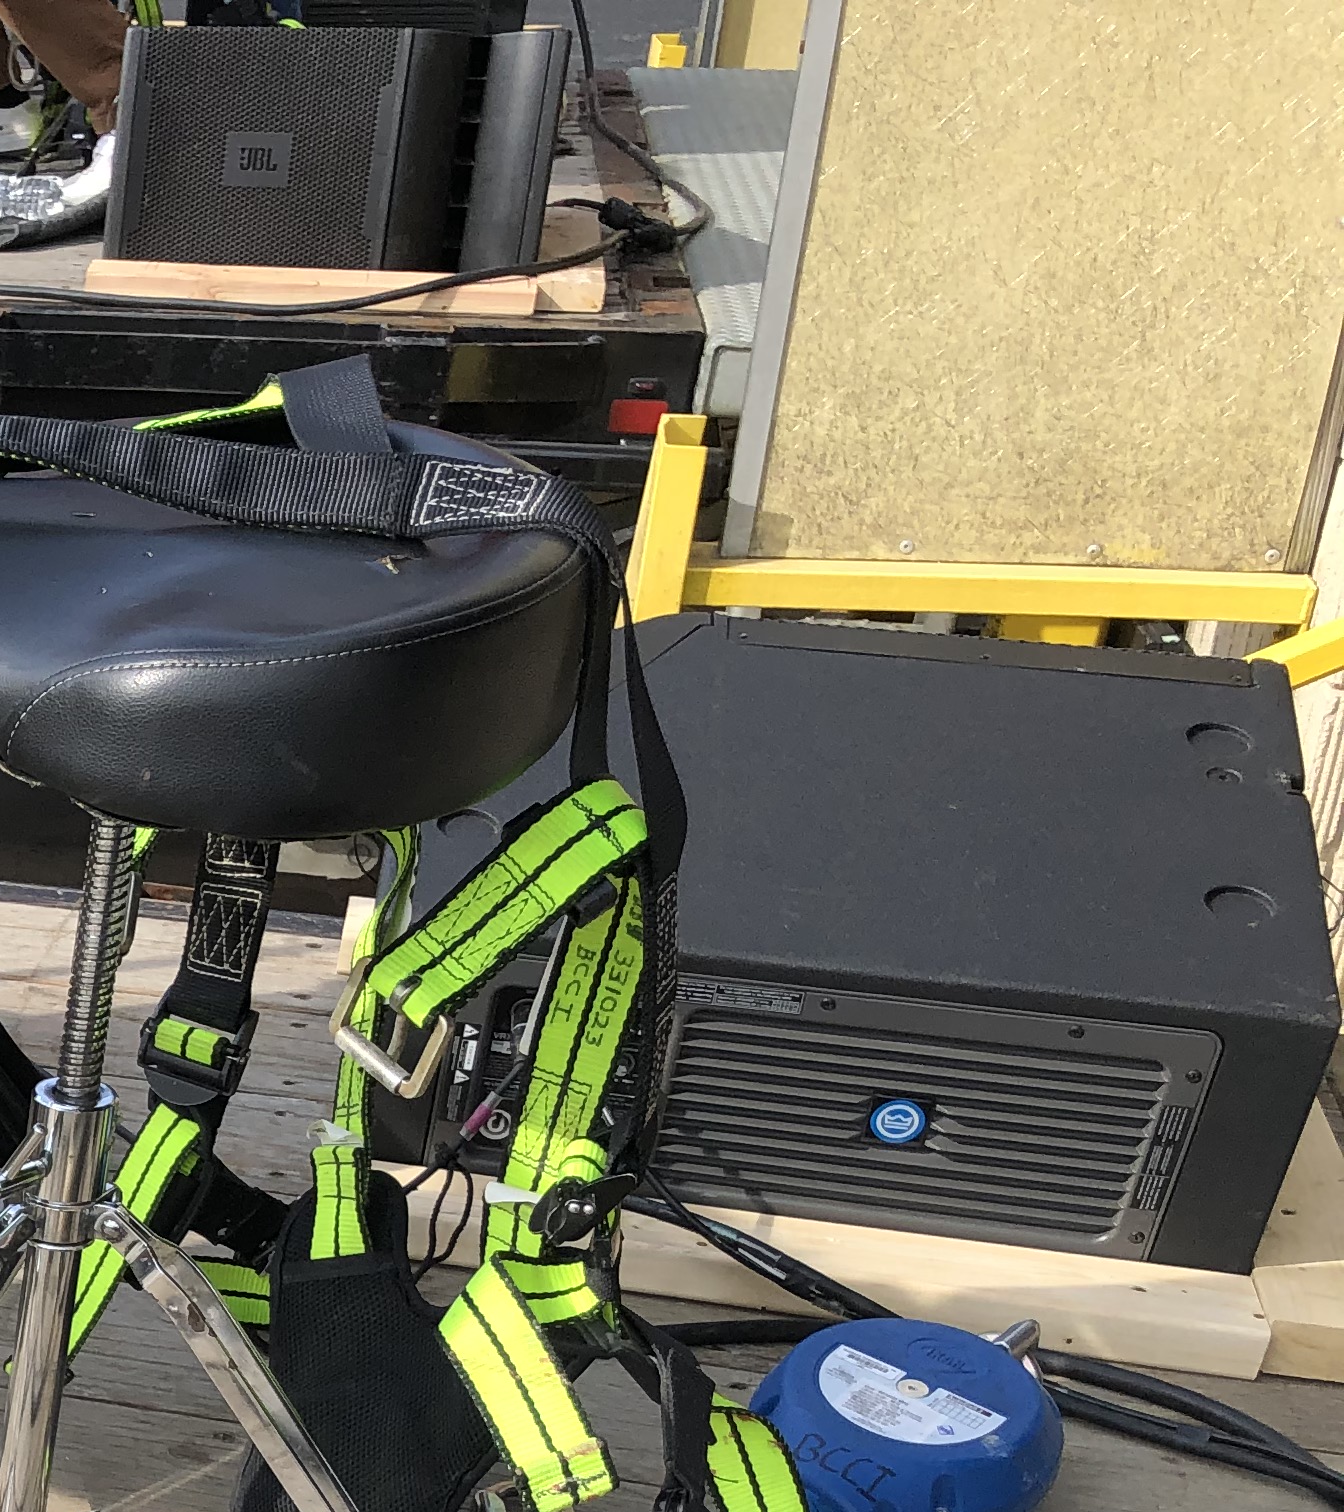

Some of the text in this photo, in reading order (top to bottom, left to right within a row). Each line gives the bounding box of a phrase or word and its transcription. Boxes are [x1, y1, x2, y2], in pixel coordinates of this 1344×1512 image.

[239, 147, 278, 171] JBL
[550, 944, 597, 1024] BCCI
[585, 949, 635, 1047] 331023
[793, 1432, 897, 1503] BCCI
